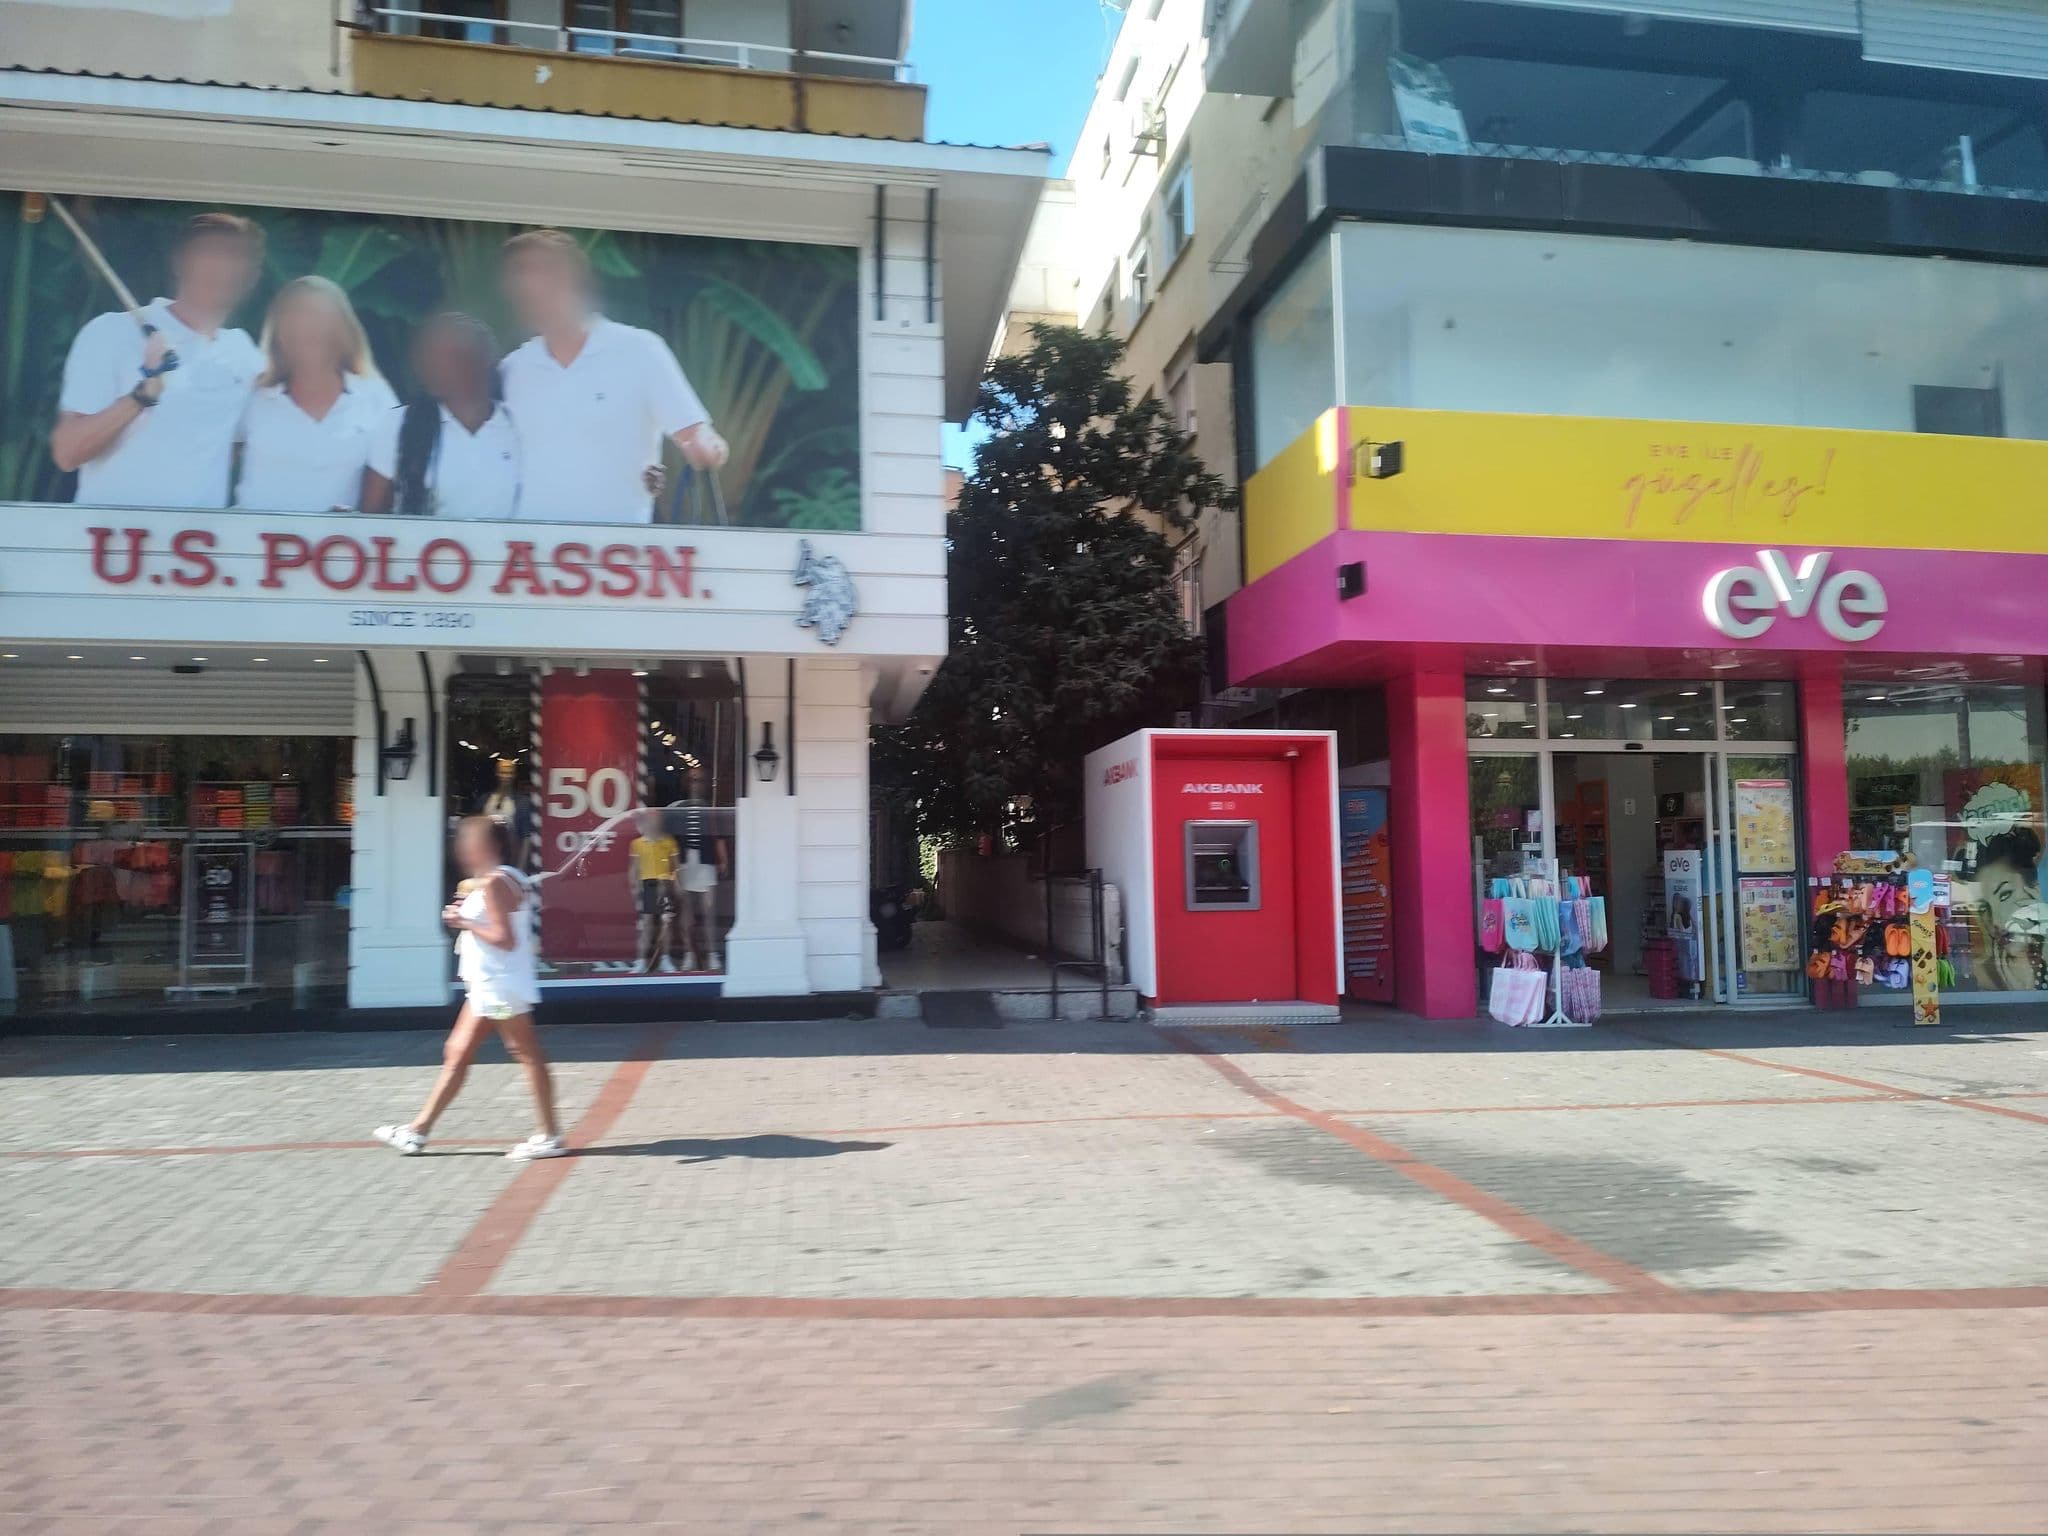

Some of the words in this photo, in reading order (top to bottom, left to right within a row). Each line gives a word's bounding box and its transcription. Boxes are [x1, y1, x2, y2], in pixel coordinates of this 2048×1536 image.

[87, 527, 236, 586] U.S.
[259, 532, 473, 593] POLO
[492, 540, 713, 600] ASSN.
[350, 610, 416, 626] SINCE
[423, 611, 474, 628] 1890
[547, 768, 632, 818] 50
[1181, 783, 1264, 794] AKBANK
[556, 831, 617, 852] OFF
